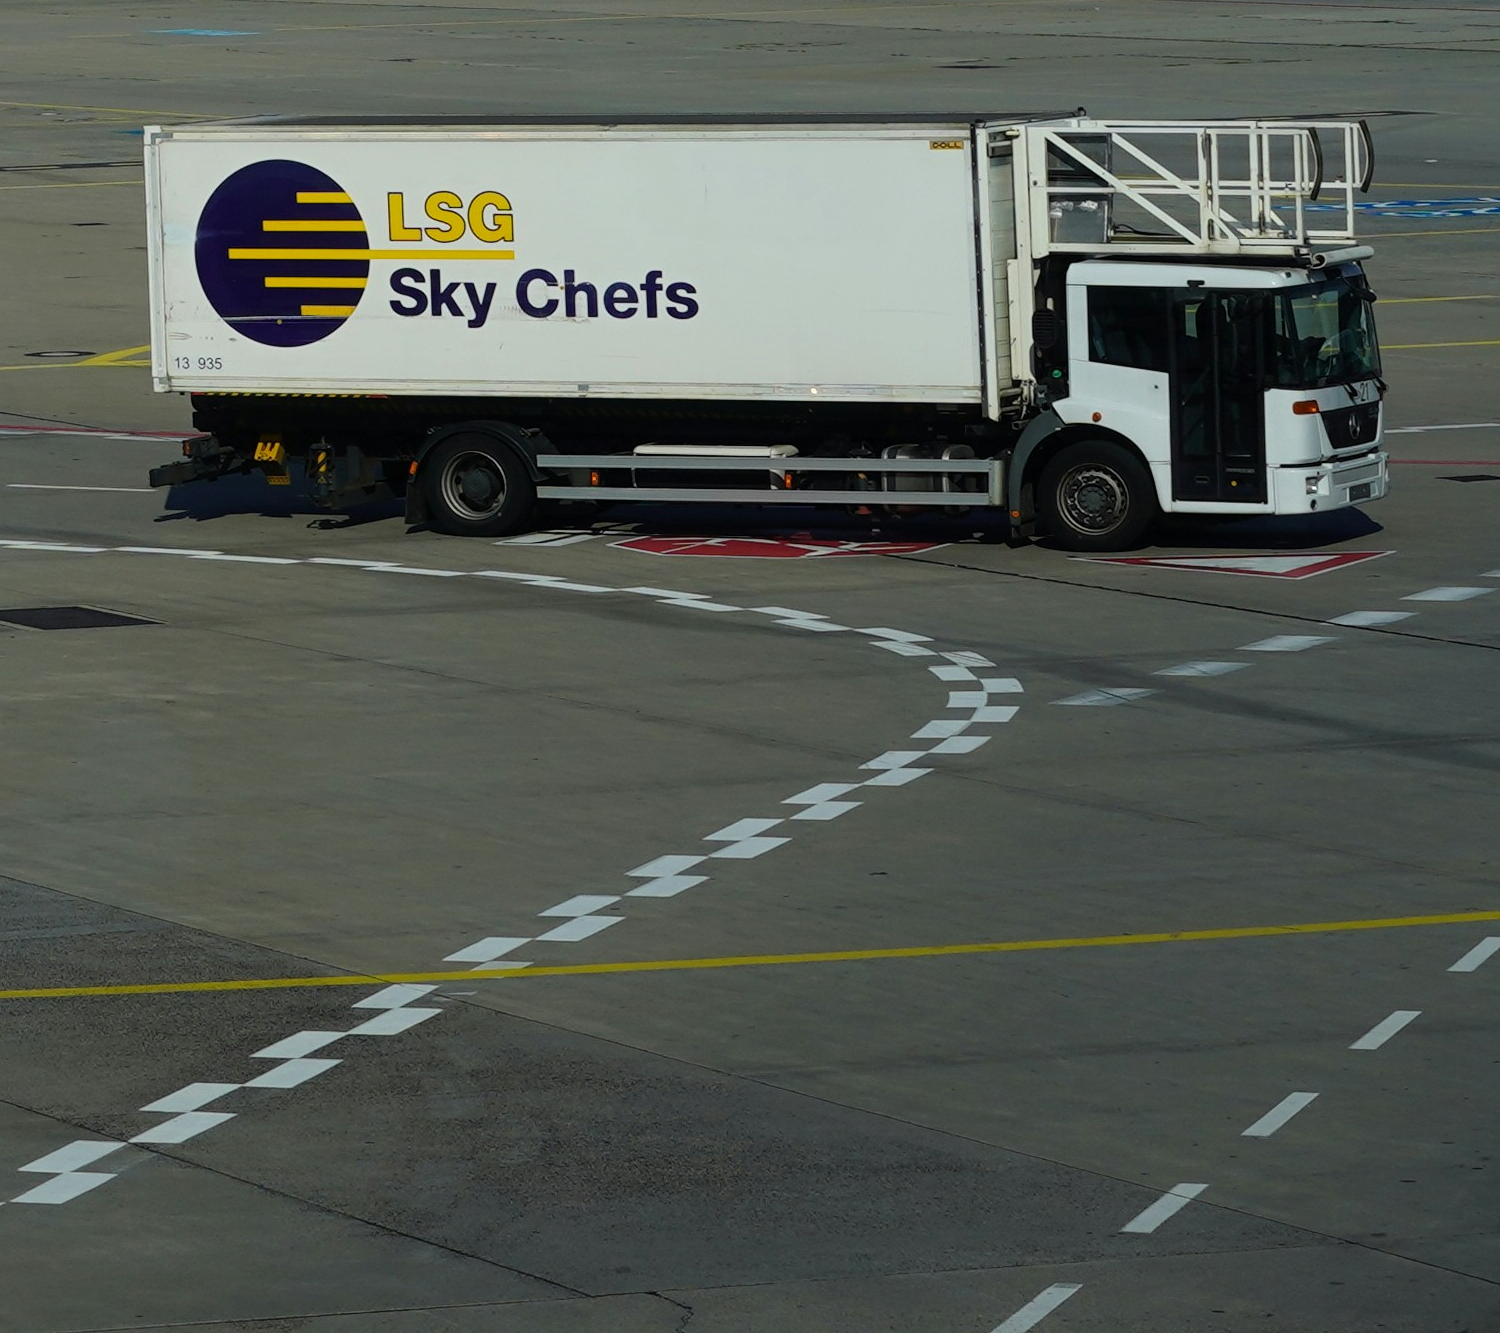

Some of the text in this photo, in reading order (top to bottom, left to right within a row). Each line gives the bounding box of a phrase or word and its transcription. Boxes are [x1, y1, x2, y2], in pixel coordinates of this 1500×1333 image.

[386, 190, 515, 243] LSG
[388, 267, 700, 329] Sky Chefs
[174, 356, 223, 370] 13 935
